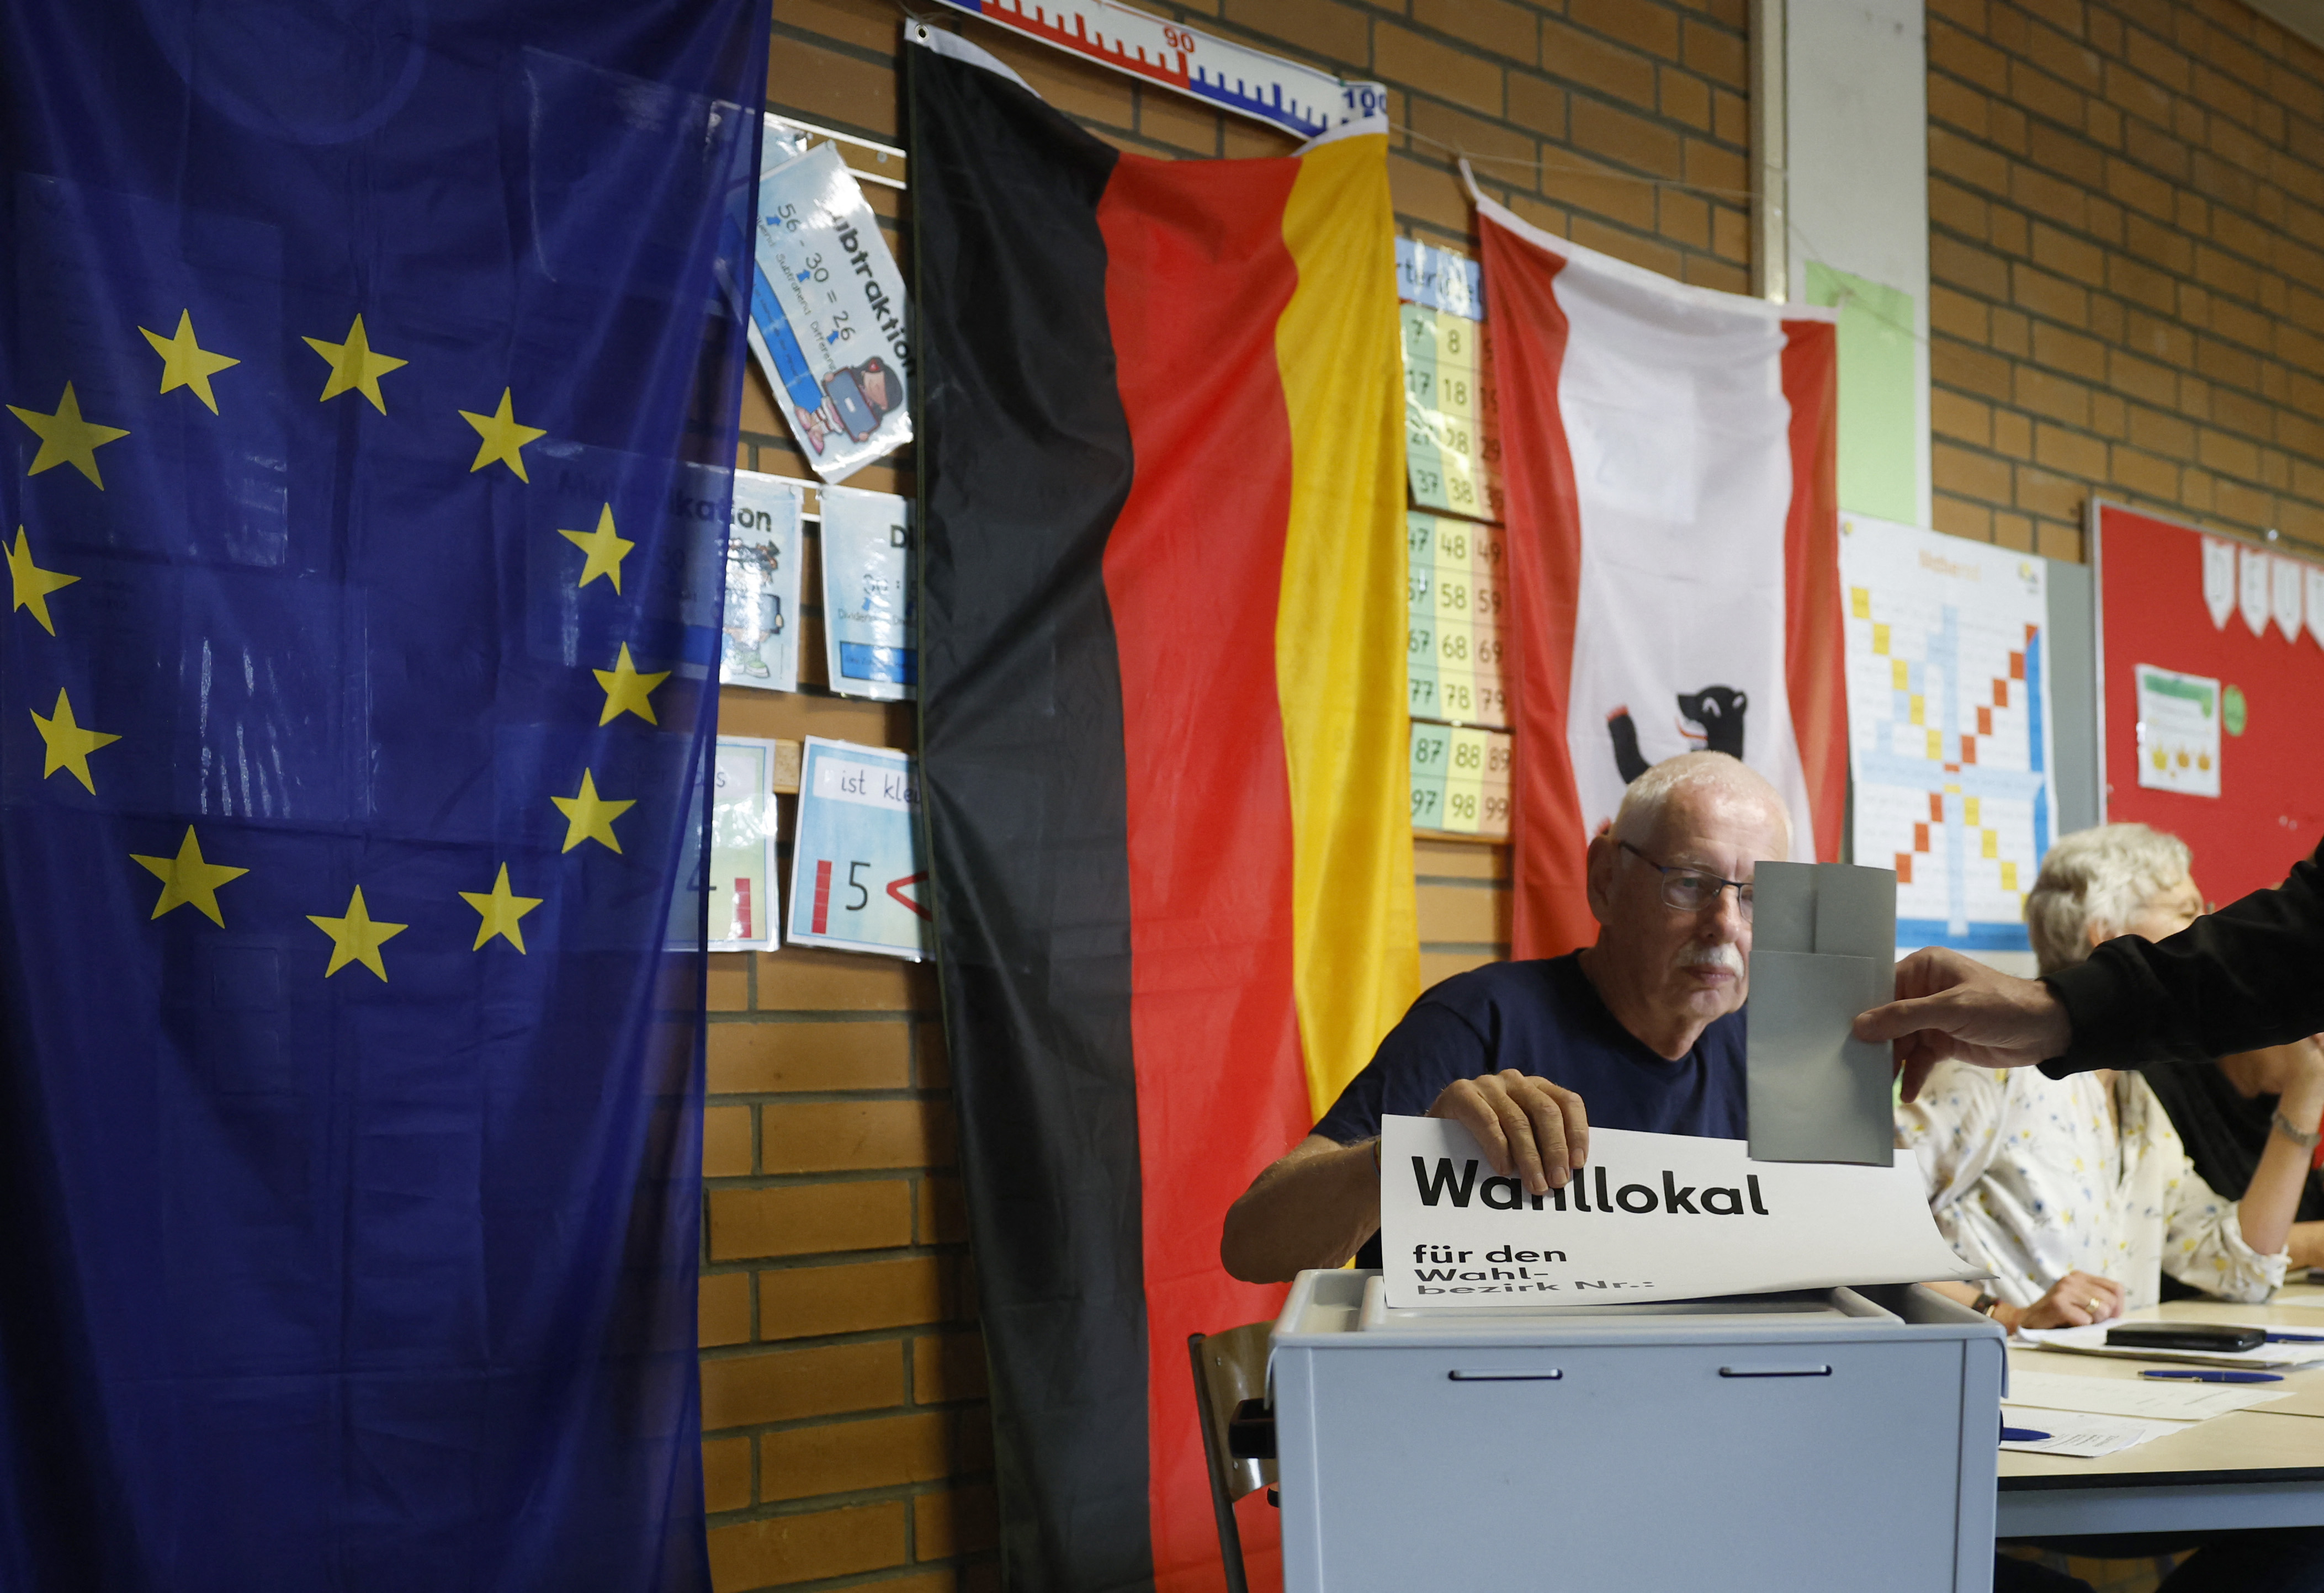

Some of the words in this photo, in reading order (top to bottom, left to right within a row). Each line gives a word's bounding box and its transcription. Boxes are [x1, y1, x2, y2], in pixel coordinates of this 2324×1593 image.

[1163, 25, 1196, 54] 90
[778, 203, 800, 233] 56
[805, 252, 830, 283] 30
[832, 310, 856, 342] 26
[828, 206, 917, 378] ubtraktion
[1447, 329, 1461, 354] 8
[1408, 369, 1431, 394] 17
[1444, 378, 1467, 406] 18
[1416, 469, 1439, 493] 37
[1448, 477, 1474, 504] 38
[1440, 532, 1467, 560] 48
[1441, 582, 1467, 610] 58
[1478, 588, 1503, 614] 59
[1409, 628, 1431, 654] 67
[1442, 634, 1467, 660] 68
[1479, 639, 1503, 663] 69
[1409, 678, 1434, 704] 77
[1445, 683, 1471, 710] 78
[1481, 688, 1506, 711] 79
[1415, 737, 1443, 764] 87
[1455, 742, 1481, 769] 88
[841, 769, 867, 795] ist
[883, 773, 921, 804] klei
[1411, 789, 1437, 816] 97
[1451, 793, 1476, 819] 98
[1485, 796, 1510, 821] 99
[845, 860, 871, 911] 5
[1413, 1244, 1473, 1264] für
[1485, 1245, 1567, 1263] den
[1413, 1266, 1549, 1282] Wahl-
[1417, 1281, 1561, 1295] bezirk
[1574, 1280, 1656, 1290] Nr.:
